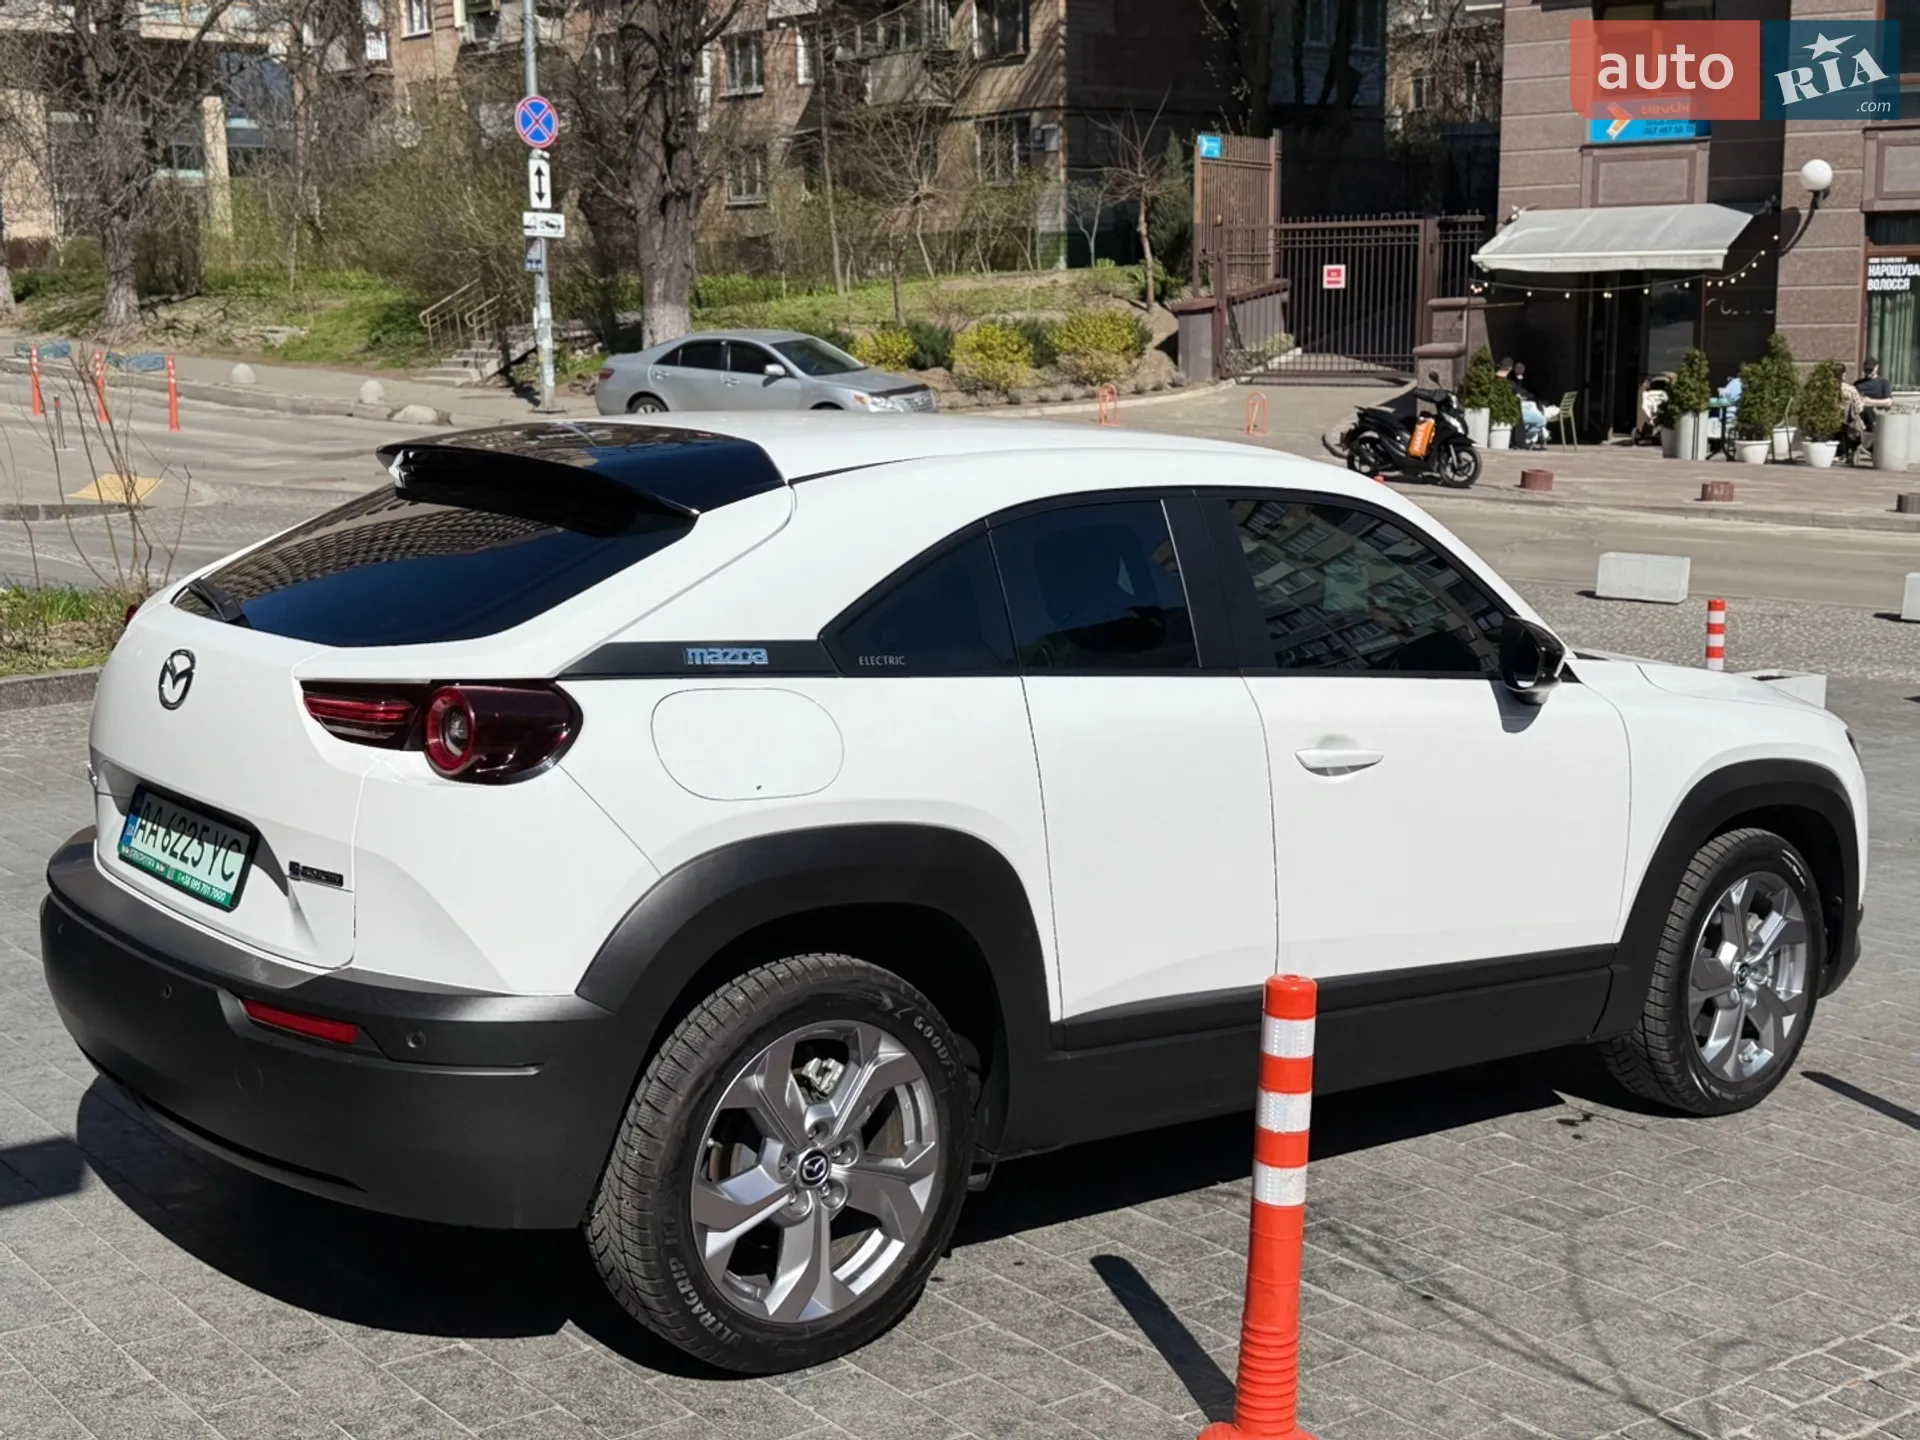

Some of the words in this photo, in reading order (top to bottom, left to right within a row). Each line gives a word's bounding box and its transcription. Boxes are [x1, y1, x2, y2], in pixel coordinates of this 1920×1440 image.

[1867, 278, 1910, 290] ВОЛОССЯ
[859, 655, 905, 665] ELECTRIC
[133, 801, 163, 849] AA
[161, 811, 210, 868] 6225
[207, 829, 241, 882] YC
